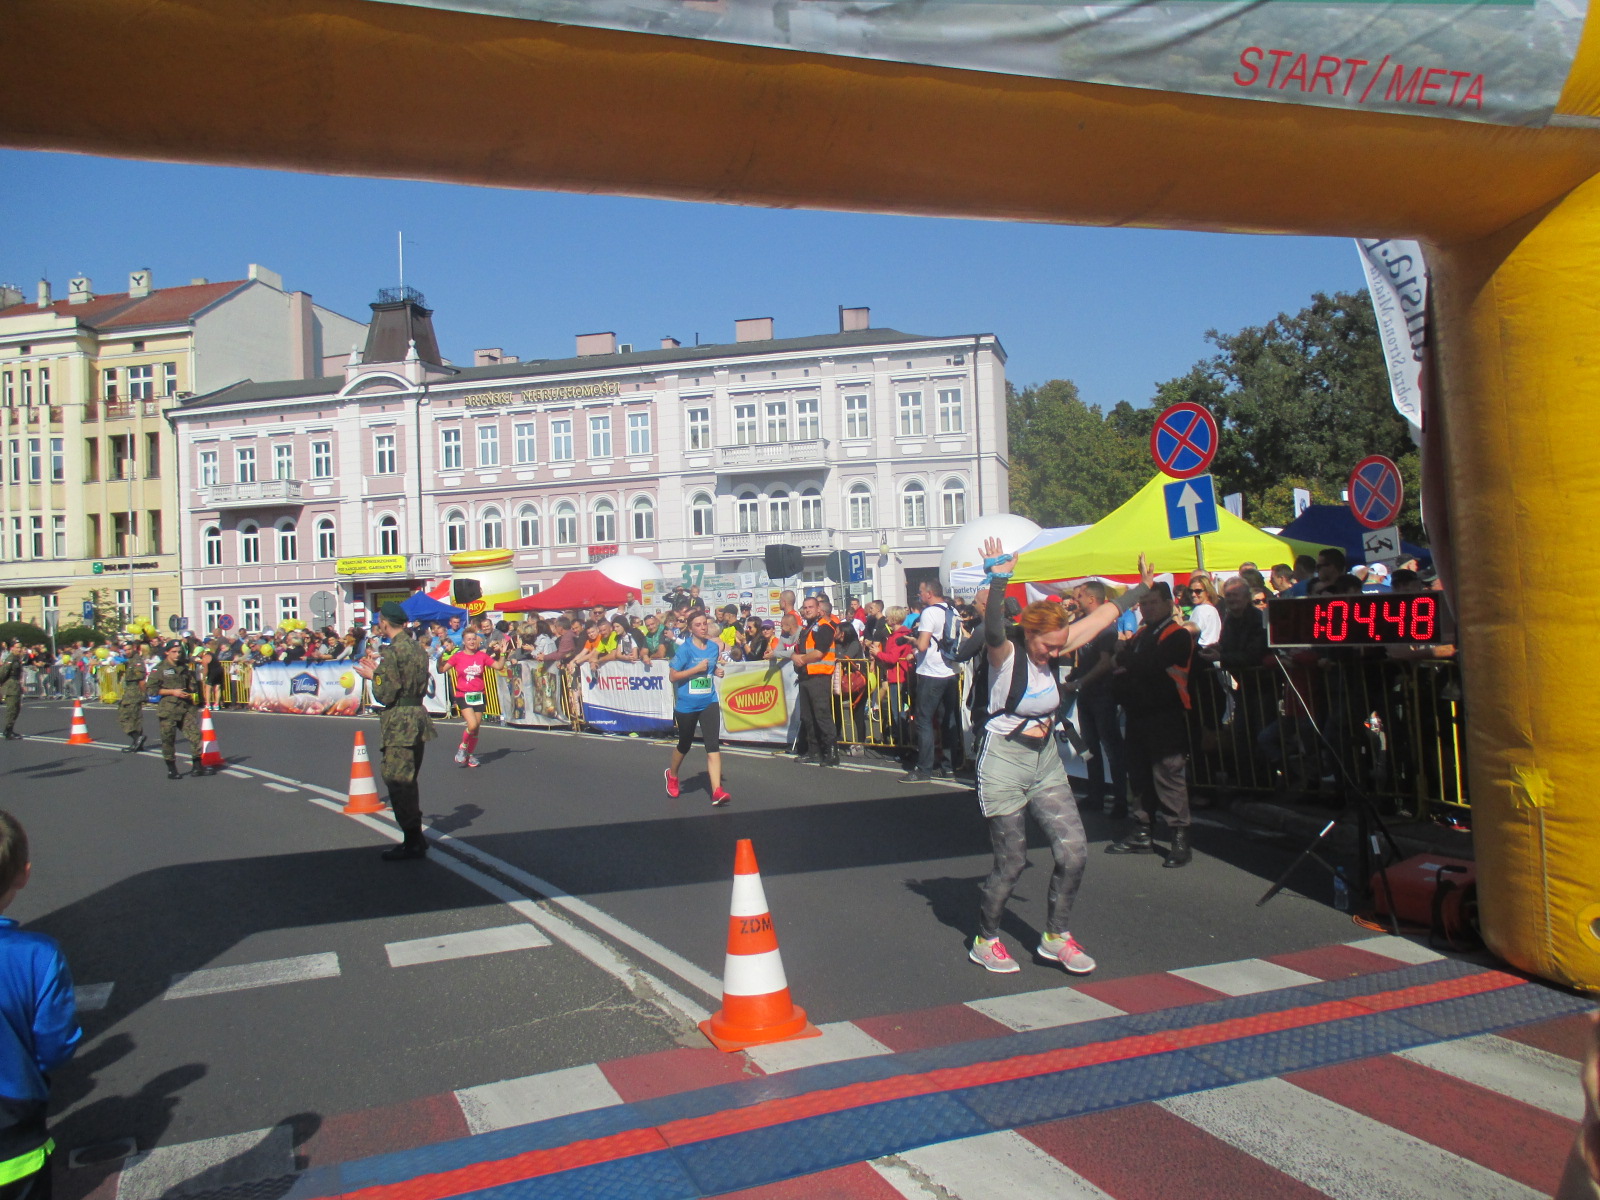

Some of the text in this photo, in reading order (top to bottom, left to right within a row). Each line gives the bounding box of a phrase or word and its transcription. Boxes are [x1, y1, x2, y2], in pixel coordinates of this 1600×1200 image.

[1233, 46, 1484, 109] START/META
[464, 381, 621, 407] BRYŃSKI NIERUCHOMOŚCI
[851, 555, 861, 574] P
[681, 564, 704, 589] 37
[1314, 597, 1435, 641] 1:04.48
[598, 676, 663, 690] INTERSPORT
[695, 679, 709, 688] 792
[735, 689, 776, 709] WINIARY
[740, 918, 772, 934] ZDM
